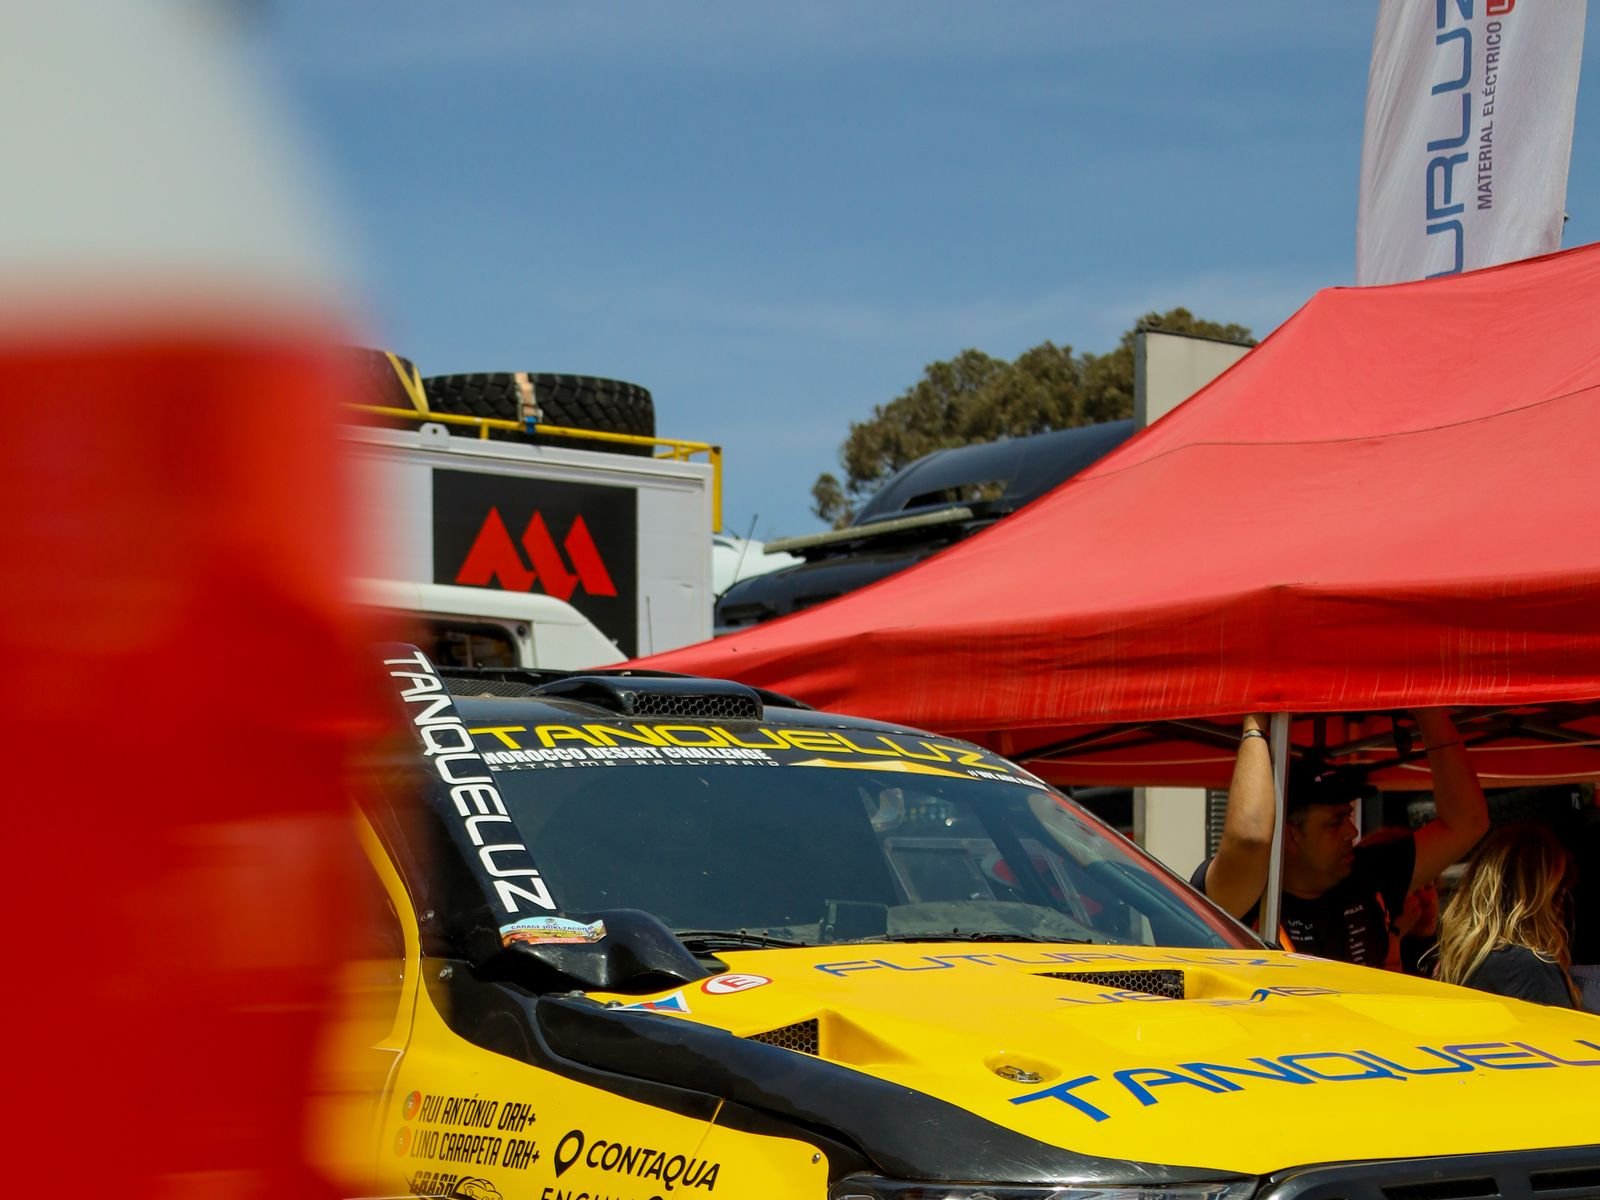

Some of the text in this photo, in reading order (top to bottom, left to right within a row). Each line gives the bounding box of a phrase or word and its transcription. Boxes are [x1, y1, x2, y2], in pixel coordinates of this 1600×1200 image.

[1477, 21, 1503, 210] MATERIAL ELÉCTRICO
[467, 724, 1008, 773] TANQUELUZ
[481, 746, 773, 765] MOROCCO DESERT CHALLENGE
[384, 651, 557, 913] TANQUELUZ
[1010, 1039, 1600, 1123] TANQUEL
[418, 1094, 445, 1124] RUI
[440, 1093, 498, 1129] ANTÓNIO
[410, 1129, 439, 1160] LINO
[438, 1132, 502, 1166] CARAPETA
[585, 1138, 721, 1192] CONTAQUA
[410, 1170, 458, 1196] CRASH
